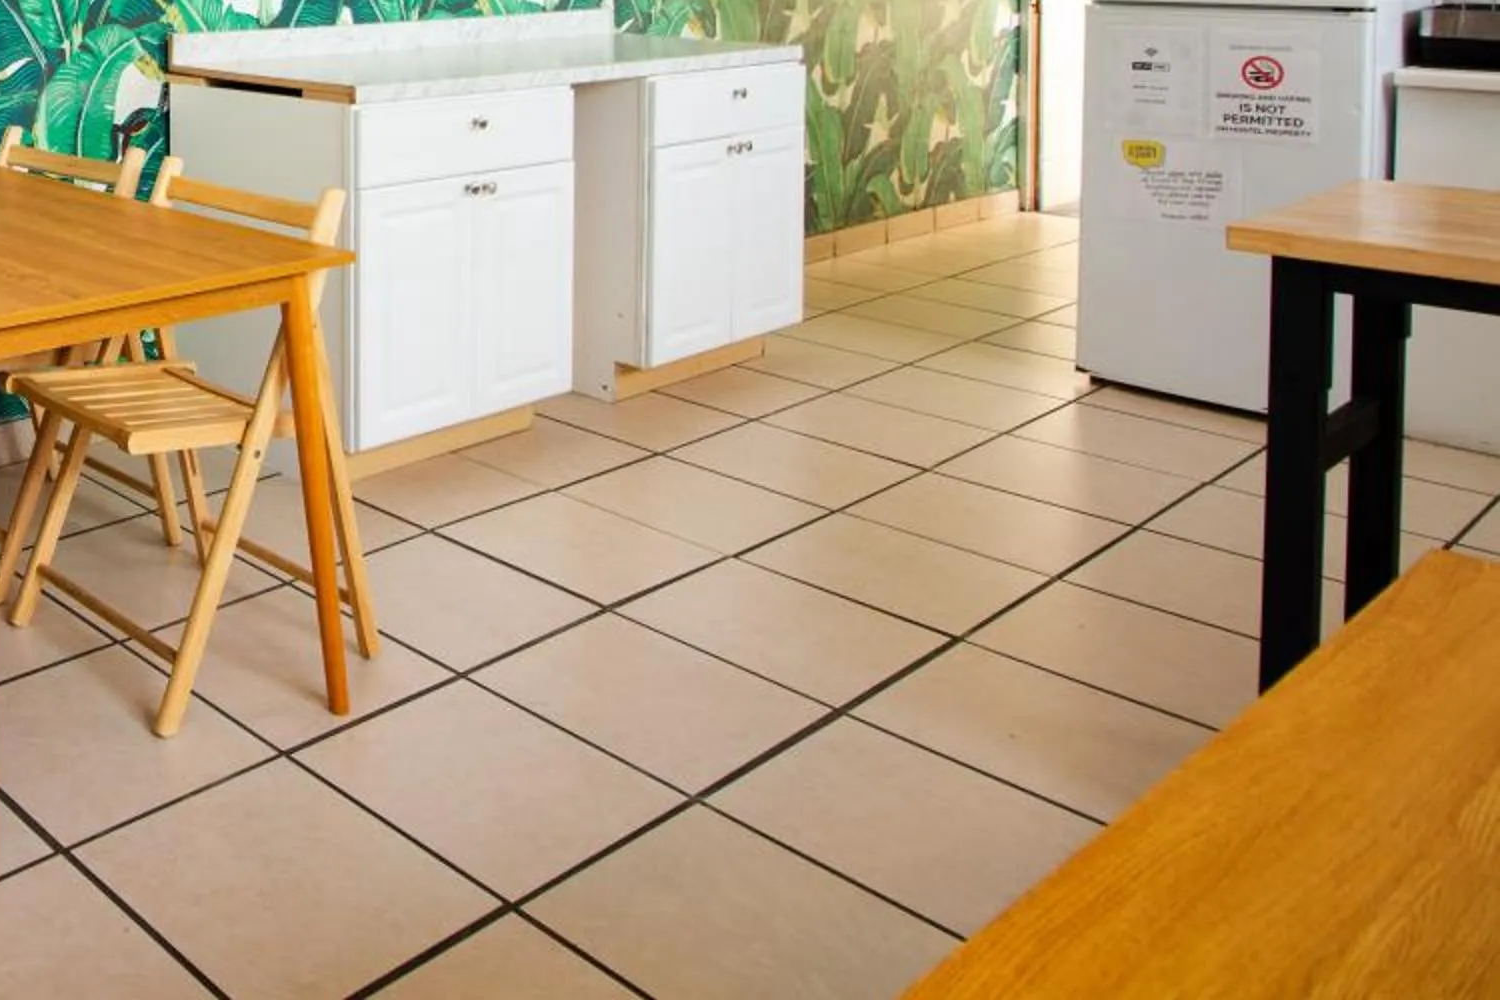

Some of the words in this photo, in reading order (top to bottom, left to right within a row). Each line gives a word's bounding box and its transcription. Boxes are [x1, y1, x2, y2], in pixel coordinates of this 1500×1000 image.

[1239, 103, 1253, 113] IS
[1255, 104, 1286, 115] NOT
[1223, 113, 1304, 128] PERMITTED
[1265, 128, 1311, 137] PROPERTY
